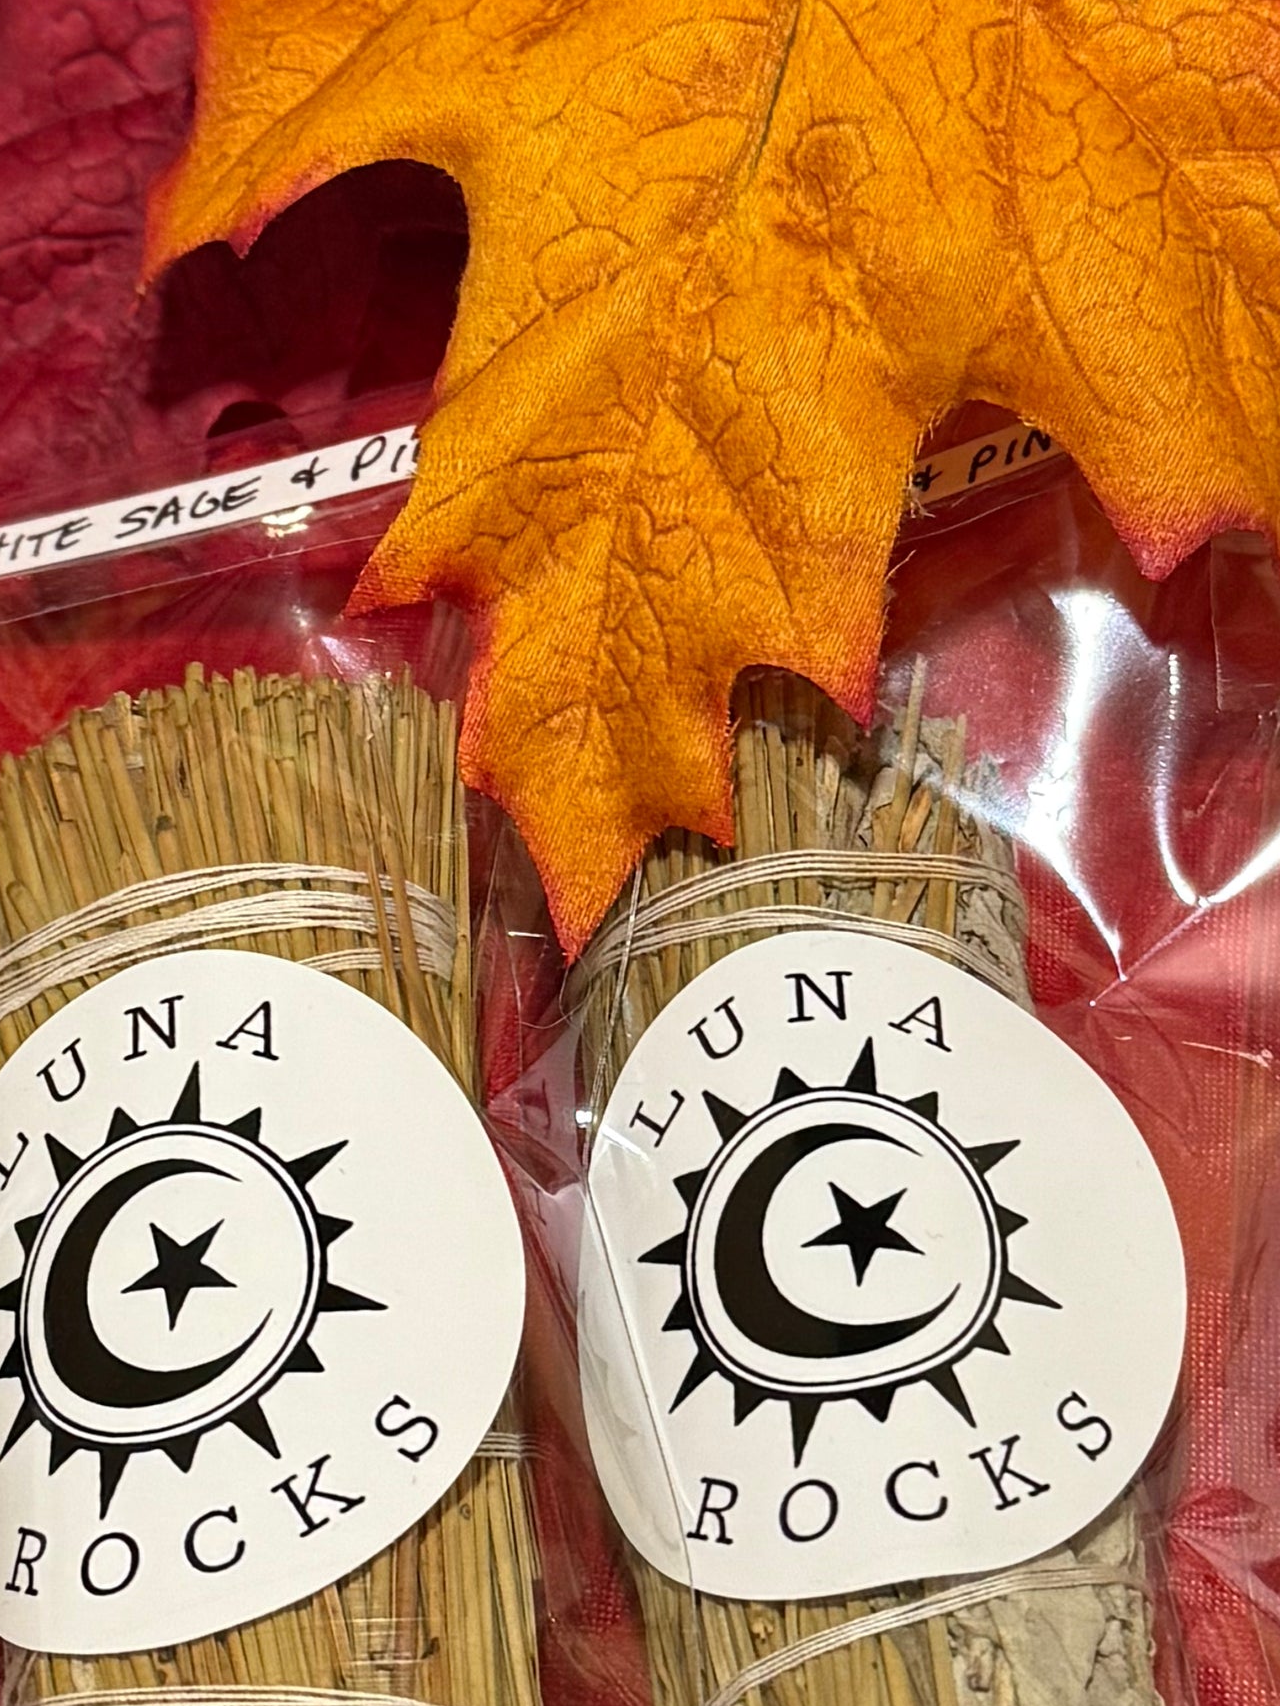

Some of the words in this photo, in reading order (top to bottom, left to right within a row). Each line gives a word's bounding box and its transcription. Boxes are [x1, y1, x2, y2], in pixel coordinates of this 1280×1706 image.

[115, 477, 263, 538] SAGE
[351, 435, 421, 481] PI
[968, 429, 1051, 483] PIN
[629, 969, 952, 1148] LUNA
[4, 1393, 439, 1596] ROCKS
[686, 1390, 1113, 1545] ROCKS
